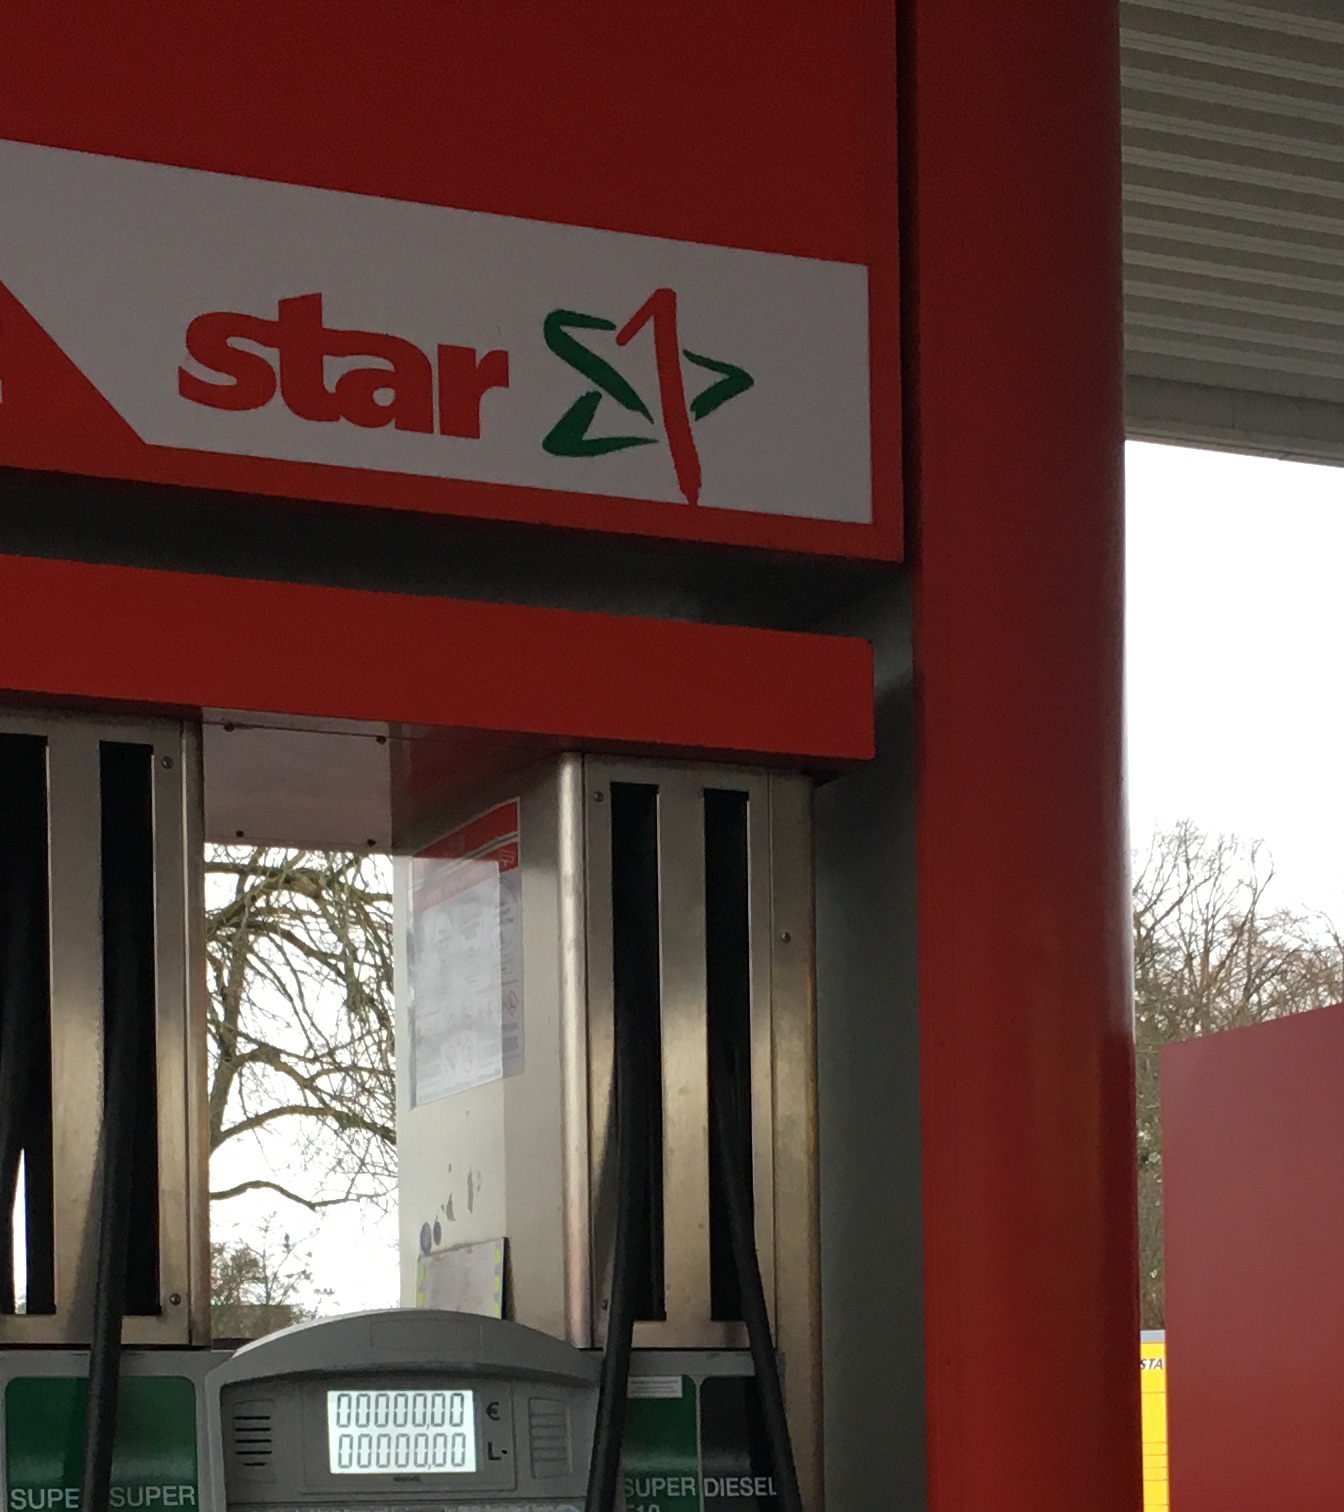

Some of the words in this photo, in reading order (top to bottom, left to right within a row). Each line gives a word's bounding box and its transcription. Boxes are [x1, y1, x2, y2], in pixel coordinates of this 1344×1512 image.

[177, 292, 510, 441] star
[484, 1400, 502, 1422] €
[9, 1486, 81, 1511] SUPE
[109, 1485, 197, 1508] SUPER
[703, 1476, 777, 1498] DIESEL
